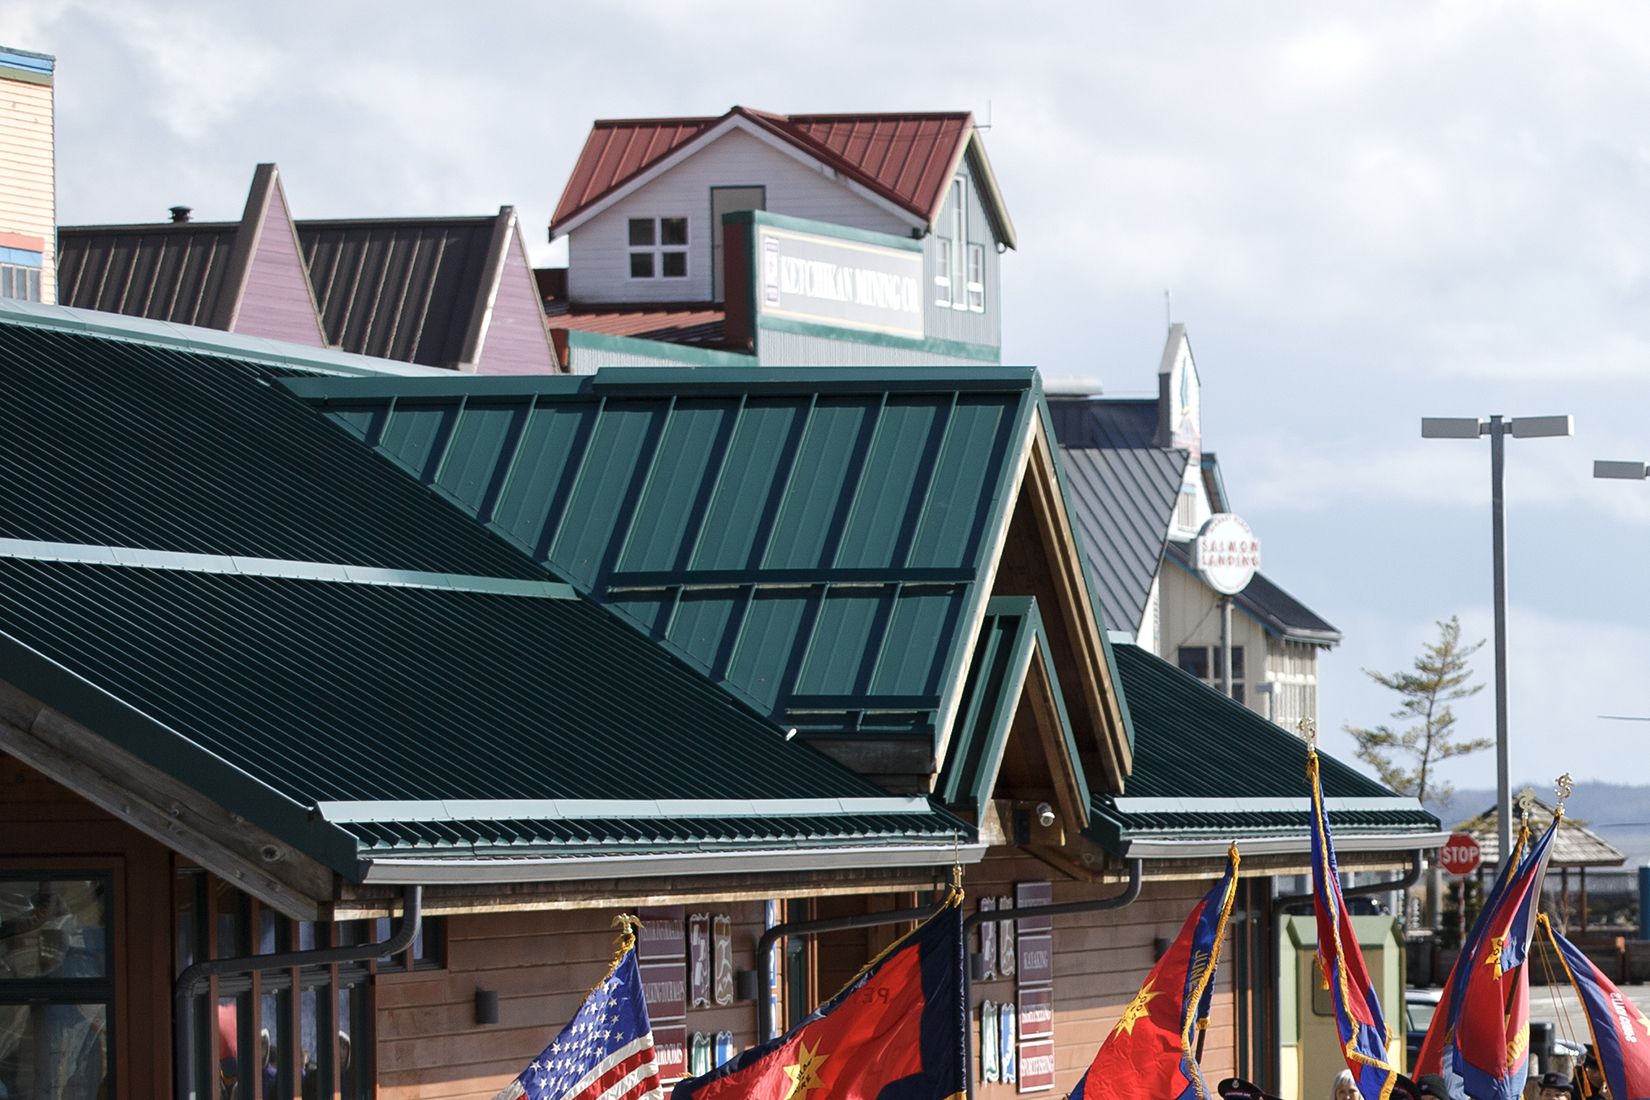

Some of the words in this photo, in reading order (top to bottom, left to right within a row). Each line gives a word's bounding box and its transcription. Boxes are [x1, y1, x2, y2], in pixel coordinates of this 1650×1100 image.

[780, 255, 853, 302] KETCHIKAN
[855, 268, 901, 311] MINING
[901, 276, 920, 314] CO.
[1202, 540, 1259, 553] SALMON
[1202, 555, 1259, 568] LANDING
[1442, 846, 1479, 864] STOP
